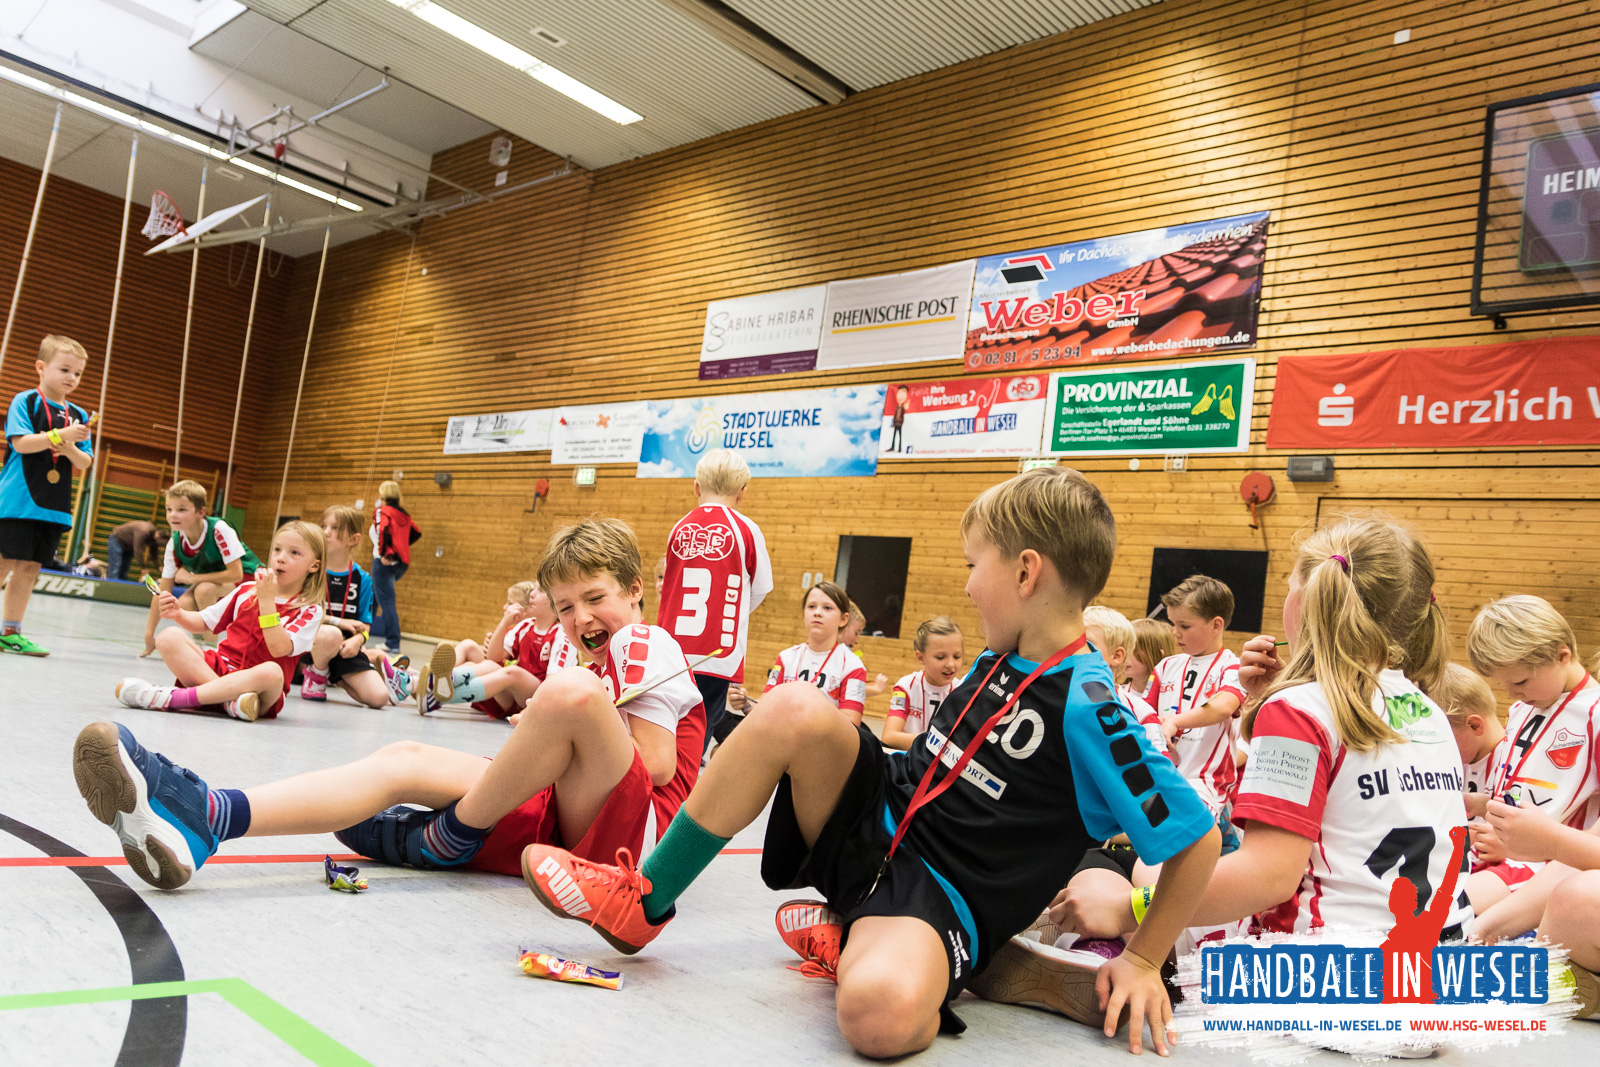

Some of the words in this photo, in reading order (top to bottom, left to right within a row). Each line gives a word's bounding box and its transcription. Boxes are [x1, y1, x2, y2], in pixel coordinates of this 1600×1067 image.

[767, 307, 815, 326] HRIBAR
[832, 302, 913, 329] RHEINISCHE
[917, 297, 959, 317] POST
[979, 289, 1147, 331] Weber
[1106, 317, 1140, 330] GmbH
[980, 329, 1040, 342] Bedachungen
[1091, 331, 1250, 357] www.weberbedachungen.de
[985, 352, 1000, 365] 02
[1003, 350, 1018, 364] 81
[1031, 349, 1041, 362] 5
[1043, 346, 1061, 361] 23
[1063, 344, 1082, 358] 94
[1063, 378, 1193, 403] PROVINZIAL
[1062, 406, 1075, 415] Die
[1075, 405, 1122, 414] Versicherung
[1123, 404, 1137, 412] der
[1146, 402, 1192, 412] Sparkassen
[1397, 387, 1573, 425] Herzlich
[723, 408, 822, 430] STADTWERKE
[986, 414, 1017, 431] WESEL
[1103, 416, 1142, 428] Egerlandt
[1143, 416, 1161, 425] und
[1162, 415, 1190, 424] Söhne
[724, 431, 774, 449] WESEL
[677, 528, 727, 549] HSG
[675, 567, 712, 637] 3
[988, 682, 1005, 697] erima
[1515, 714, 1546, 758] 4
[1357, 768, 1390, 800] SV
[536, 856, 593, 917] PUMA
